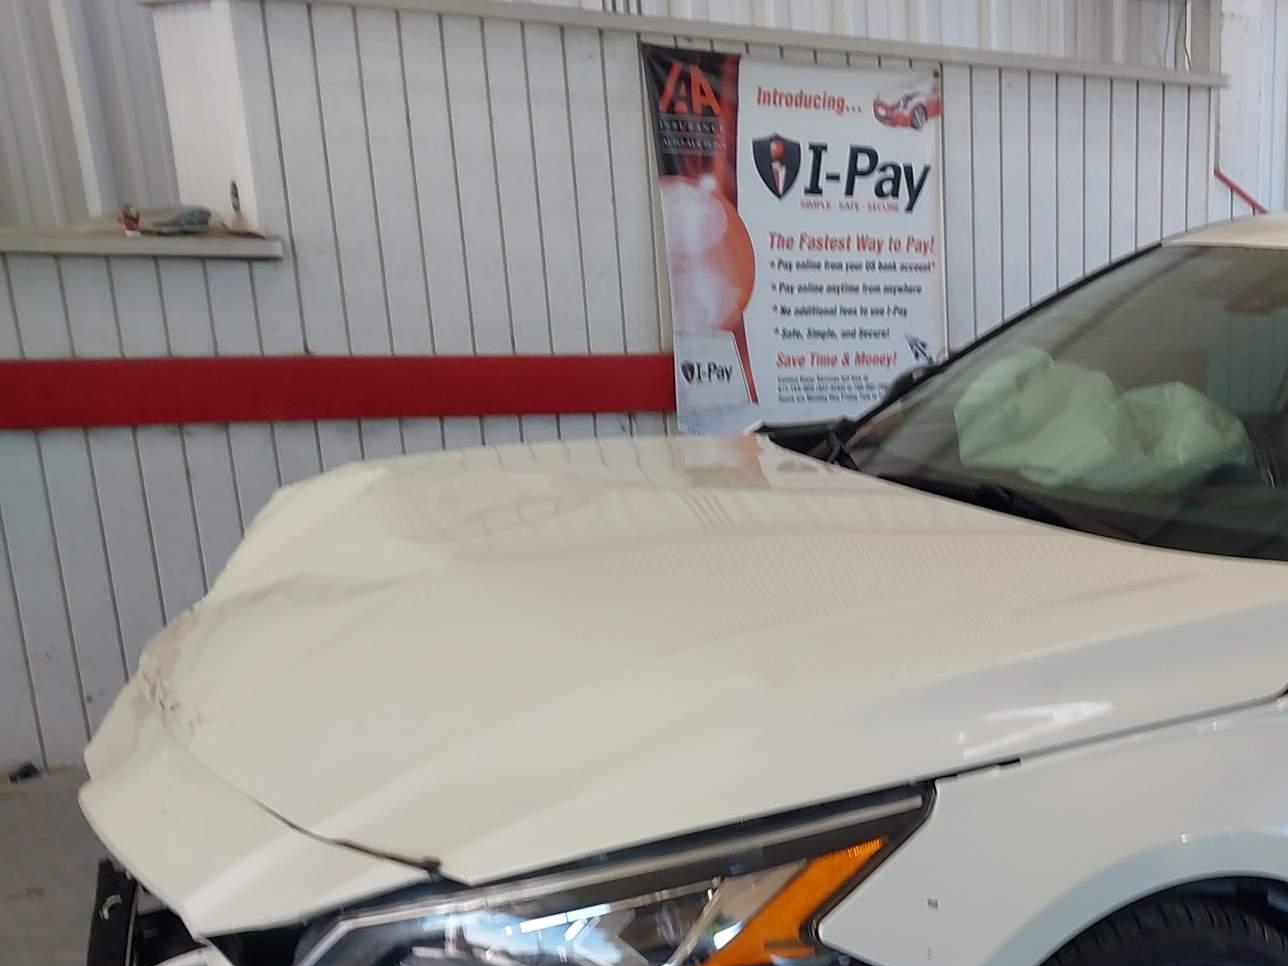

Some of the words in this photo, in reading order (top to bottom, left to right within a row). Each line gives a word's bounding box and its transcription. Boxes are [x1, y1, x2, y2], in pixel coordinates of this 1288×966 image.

[757, 86, 862, 115] Introducing...
[804, 142, 931, 213] I-Pay
[769, 231, 794, 250] The
[799, 232, 852, 251] Fastest
[856, 234, 883, 254] Way
[888, 235, 901, 251] to
[906, 236, 935, 256] Pay!
[777, 258, 792, 272] Pay
[796, 259, 821, 271] online
[824, 259, 843, 271] from
[846, 261, 862, 274] your
[878, 260, 897, 271] bank
[778, 282, 793, 295] Pay
[797, 282, 824, 294] online
[862, 282, 881, 295] from
[780, 304, 791, 316] No
[859, 304, 868, 316] to
[840, 327, 856, 339] and
[776, 351, 806, 368] Save
[810, 352, 838, 368] Time
[841, 351, 850, 367] &
[854, 351, 897, 369] Money!
[696, 361, 733, 384] I-Pay
